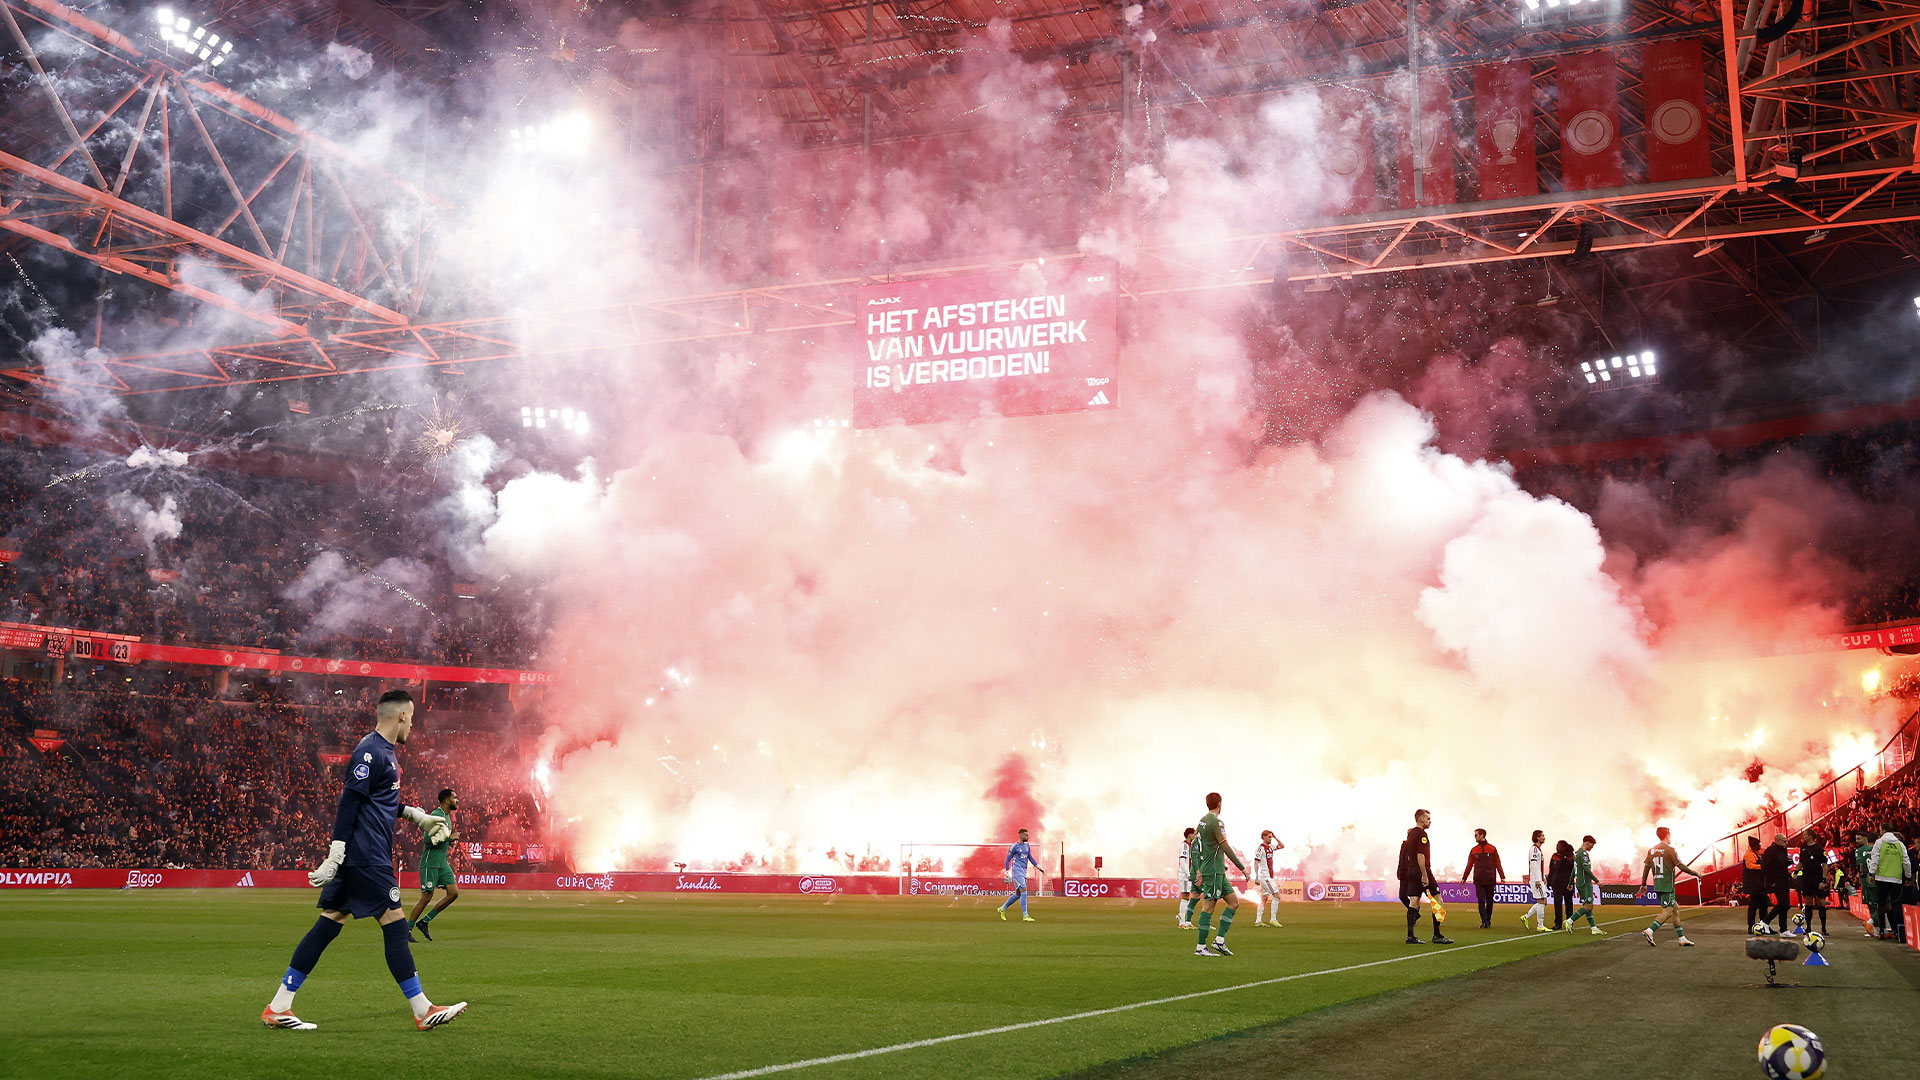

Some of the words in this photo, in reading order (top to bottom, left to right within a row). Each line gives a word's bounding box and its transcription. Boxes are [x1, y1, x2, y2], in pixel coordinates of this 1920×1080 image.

[867, 296, 901, 306] AJAX
[867, 309, 918, 335] HET
[922, 294, 1065, 330] AFSTEKEN
[866, 335, 923, 361] VAN
[928, 319, 1087, 356] VUURWERK
[866, 365, 890, 388] IS
[896, 350, 1049, 385] VERBODEN!
[1841, 634, 1871, 646] CUP
[76, 640, 103, 657] BOYZ
[108, 644, 127, 659] 423
[1653, 856, 1664, 873] 14
[128, 870, 162, 887] Ziggo
[675, 876, 721, 890] Sandals
[1065, 880, 1108, 897] Ziggo
[1141, 880, 1180, 899] Zigg
[1494, 884, 1531, 893] IENDEN
[1602, 891, 1634, 899] Heineken
[1493, 893, 1527, 903] OTERIJ
